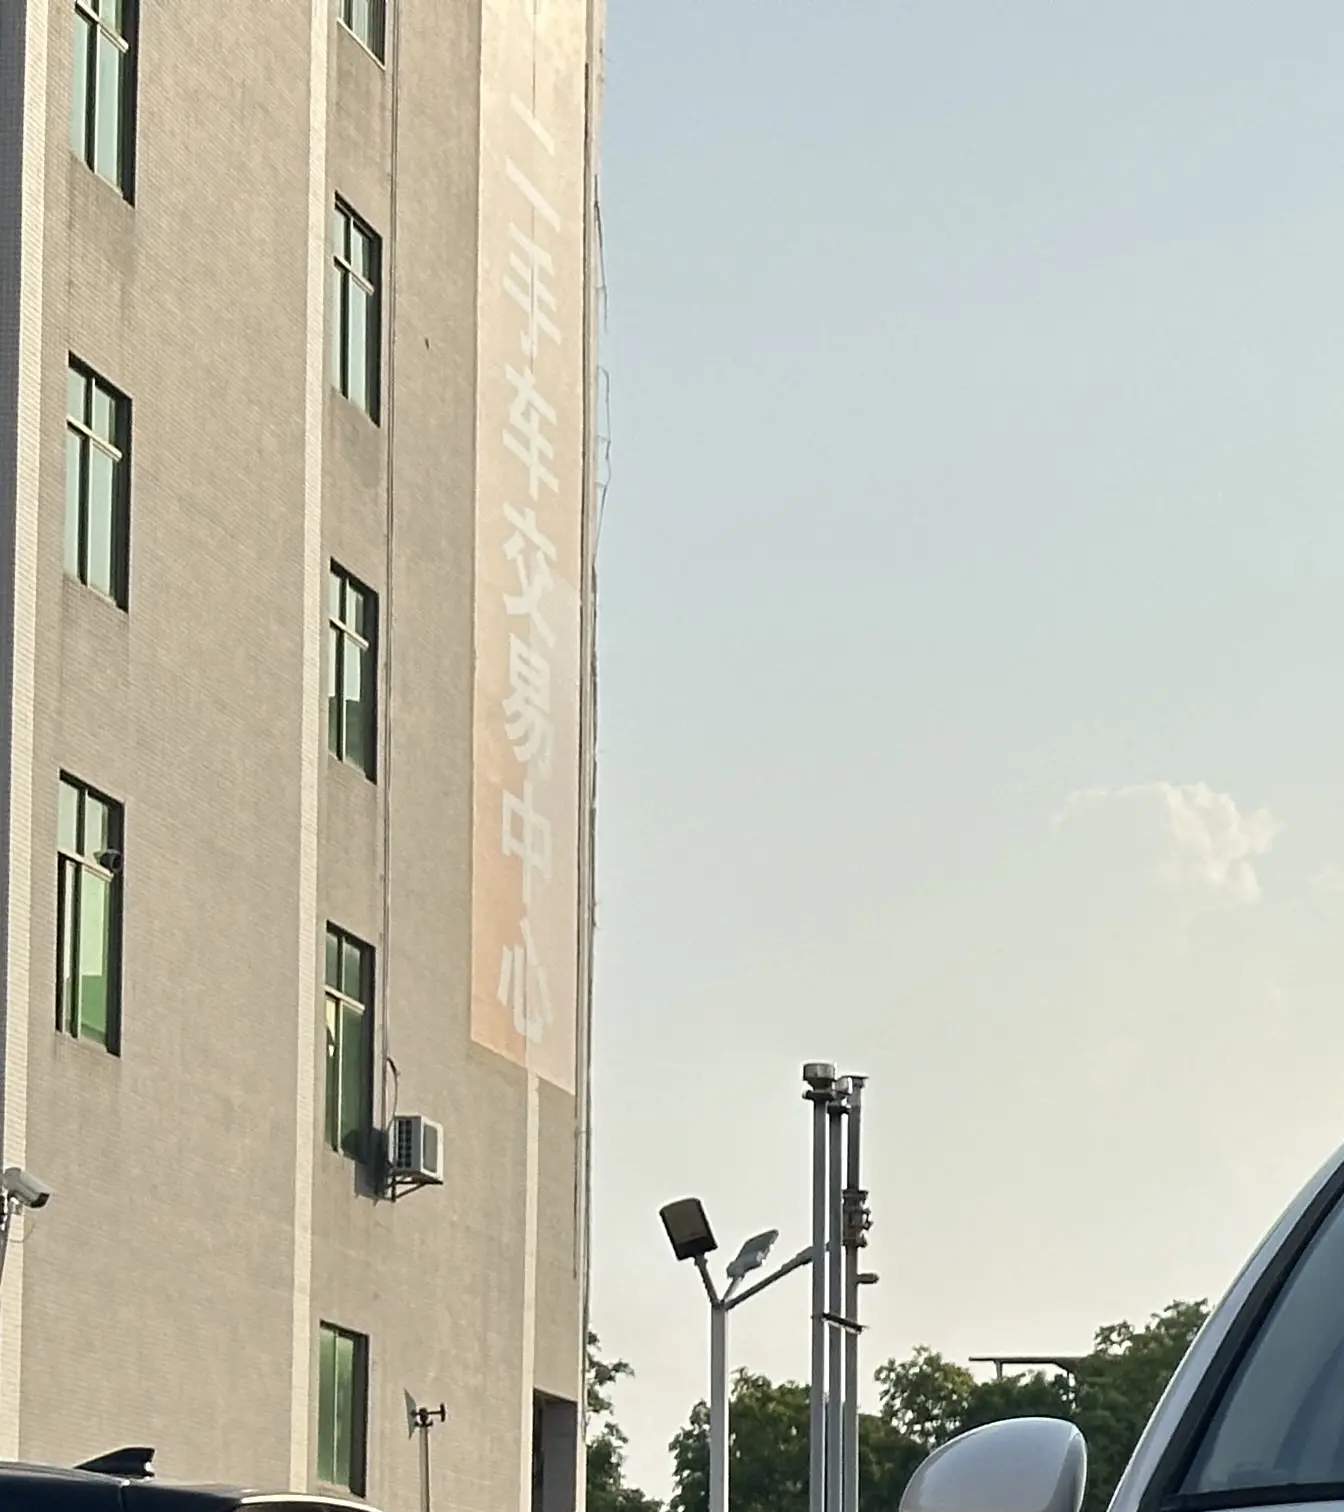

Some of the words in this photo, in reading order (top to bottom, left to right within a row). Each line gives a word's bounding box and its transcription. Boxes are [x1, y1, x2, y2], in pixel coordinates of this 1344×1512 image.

[496, 90, 562, 1046] 二手车交易中心
